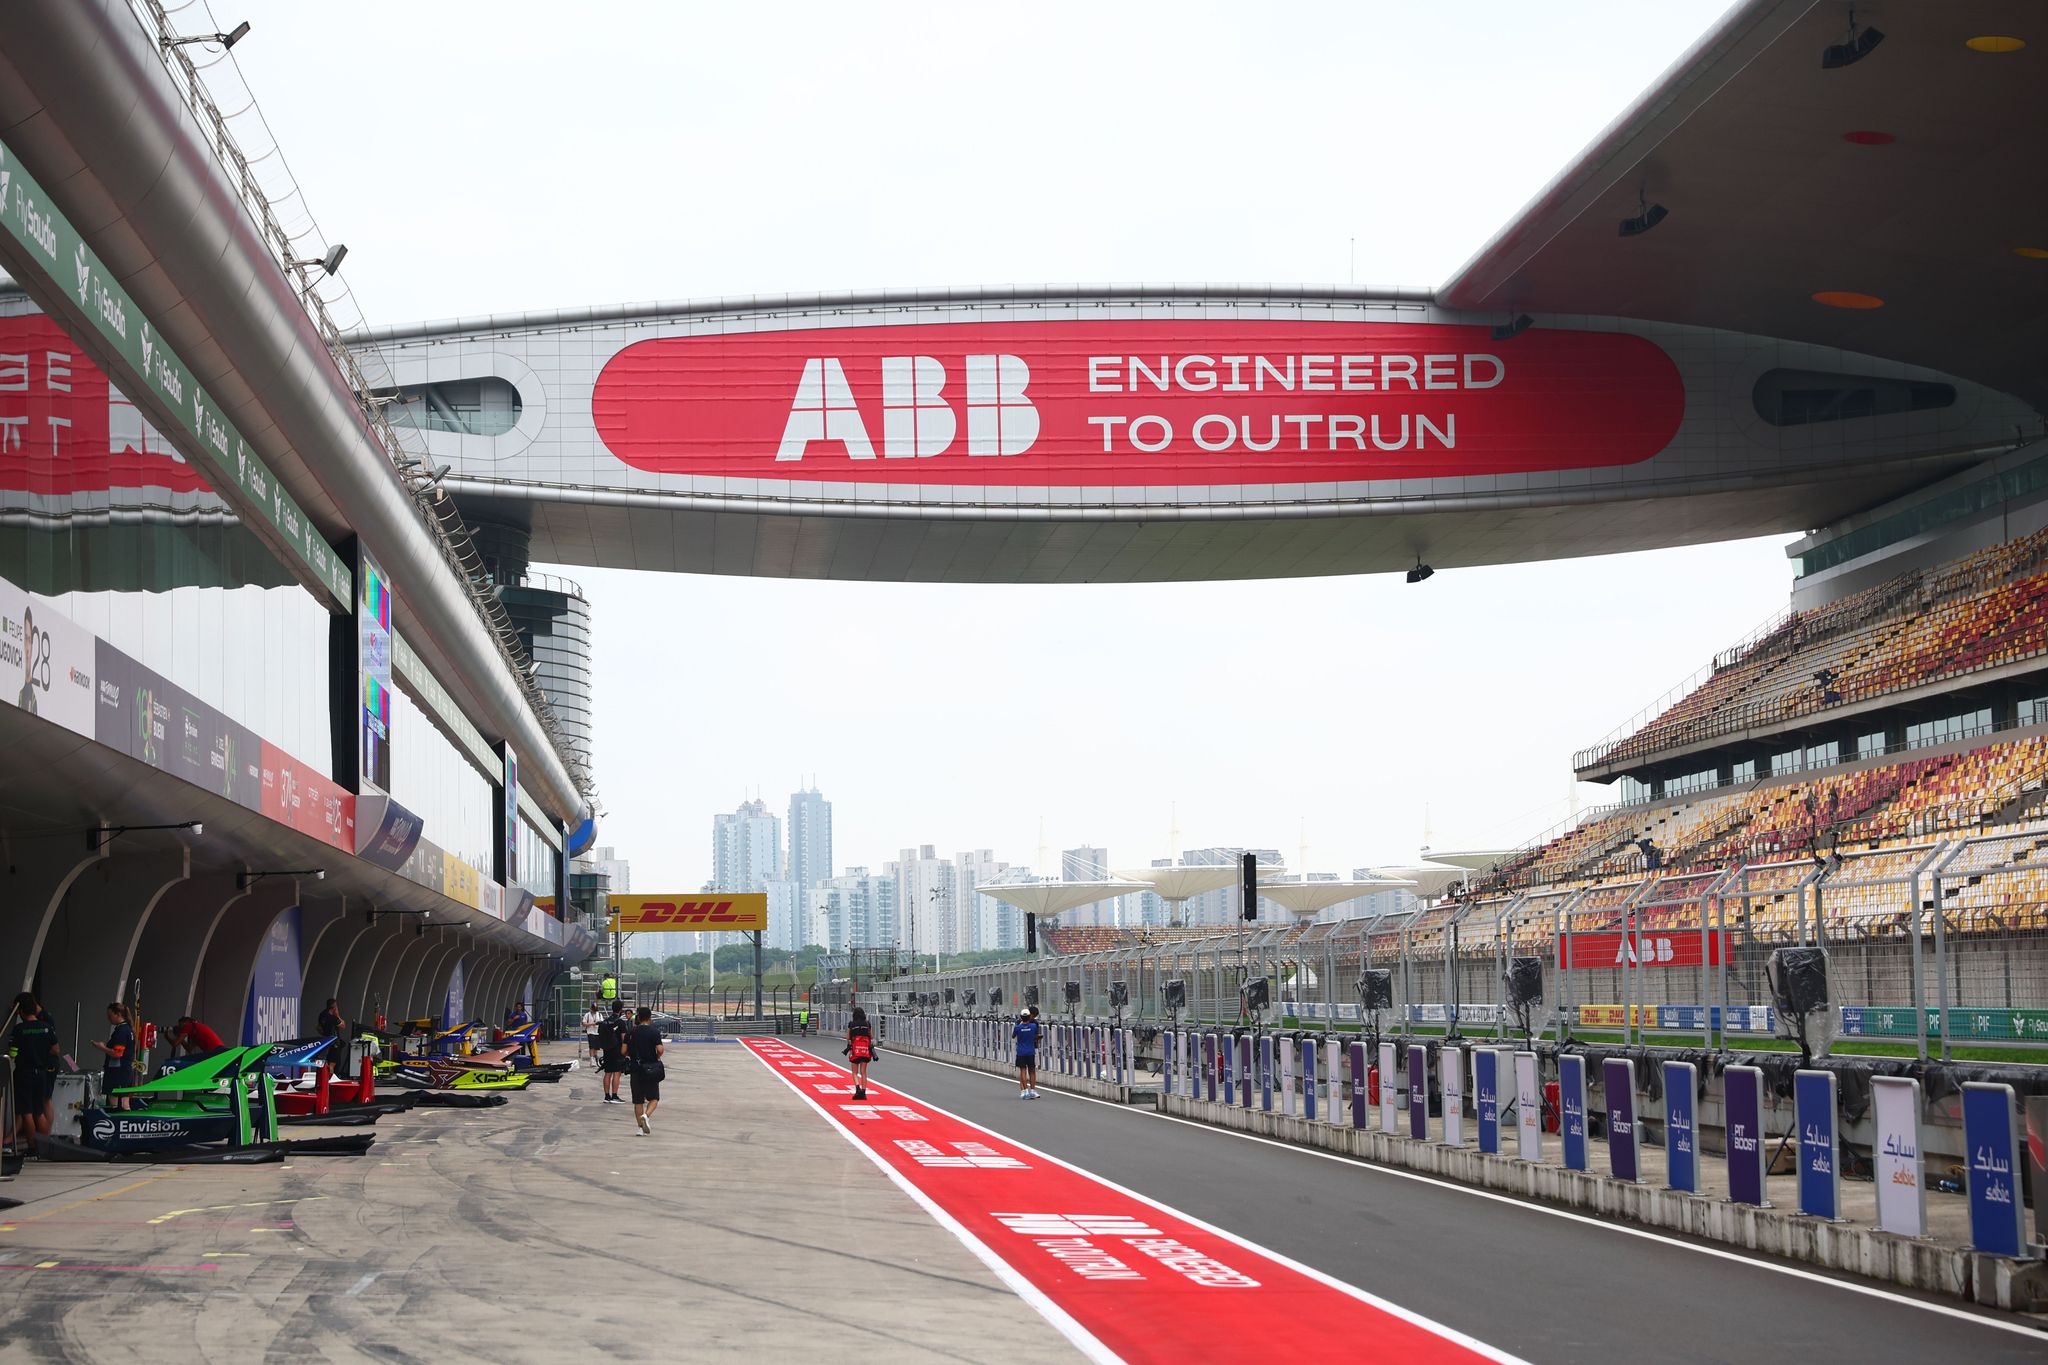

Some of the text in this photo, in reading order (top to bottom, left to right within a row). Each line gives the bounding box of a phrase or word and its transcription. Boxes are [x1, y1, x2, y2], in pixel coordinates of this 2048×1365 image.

[1089, 353, 1506, 393] ENGINEERED
[775, 354, 1040, 461] ABB
[1088, 412, 1456, 453] TO OUTRUN
[639, 902, 737, 923] DHL
[1615, 938, 1674, 963] ABB
[257, 996, 298, 1044] SHANGHAI
[1883, 1014, 1893, 1029] PIF
[1929, 1014, 1940, 1030] PIF
[1978, 1015, 1990, 1031] PIF
[1613, 1109, 1621, 1121] PIT
[120, 1119, 180, 1133] Envision
[1613, 1121, 1632, 1134] BOOST
[1734, 1123, 1745, 1137] PIT
[1734, 1137, 1757, 1152] BOOST
[1812, 1152, 1831, 1173] sabic
[1892, 1163, 1916, 1186] sabic
[1985, 1178, 2011, 1203] sabic
